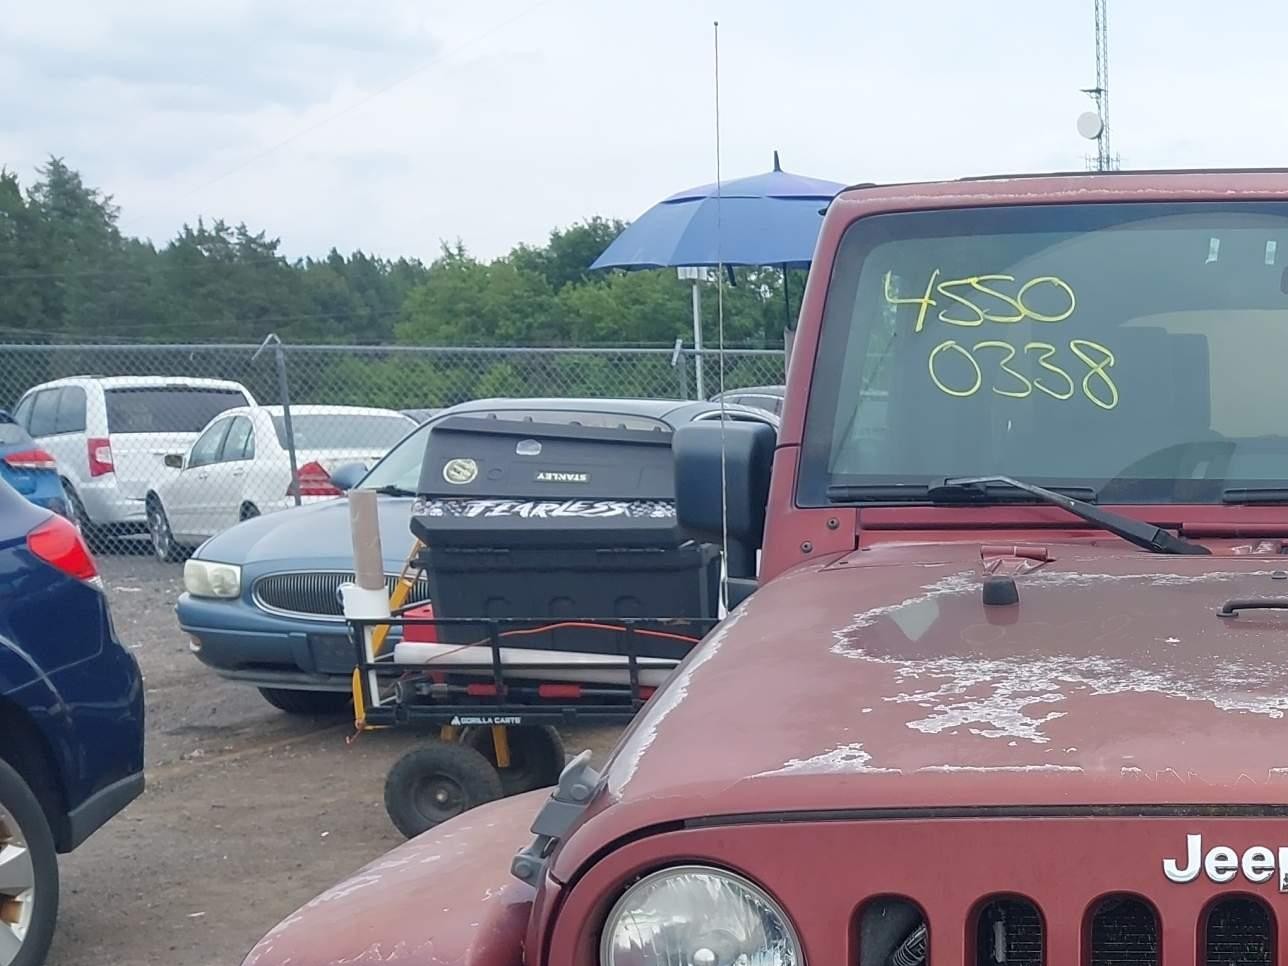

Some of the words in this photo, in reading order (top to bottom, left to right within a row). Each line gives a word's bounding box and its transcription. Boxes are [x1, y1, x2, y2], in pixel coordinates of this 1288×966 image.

[884, 268, 1076, 333] 4550
[928, 339, 1119, 409] 0338
[537, 472, 587, 482] STANLEY
